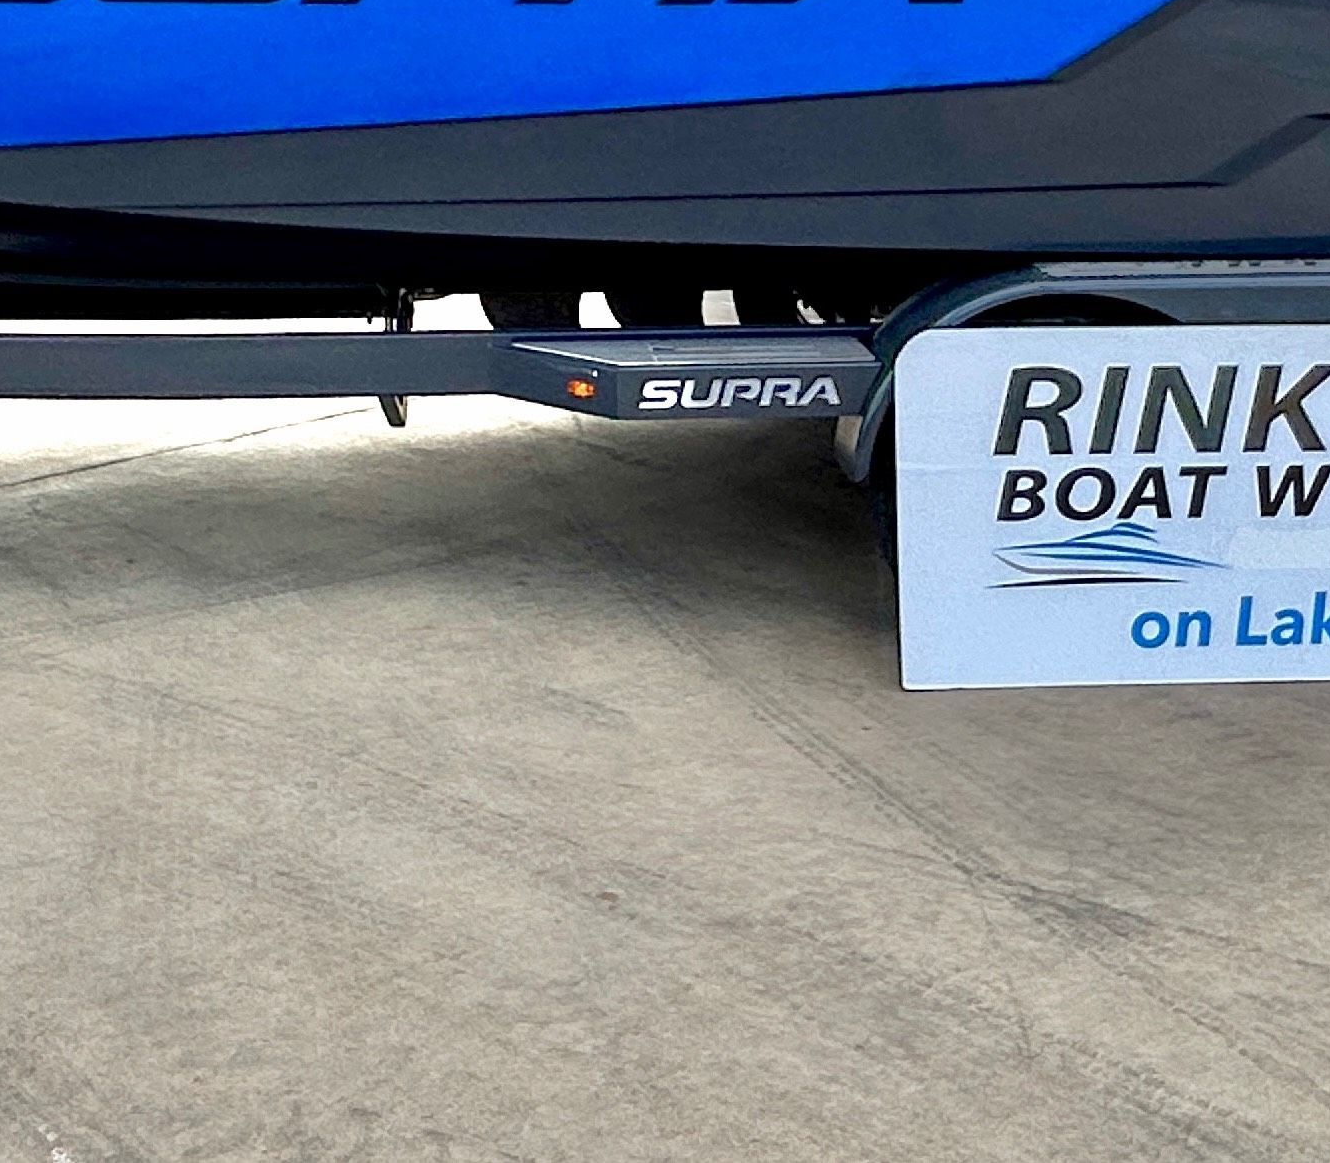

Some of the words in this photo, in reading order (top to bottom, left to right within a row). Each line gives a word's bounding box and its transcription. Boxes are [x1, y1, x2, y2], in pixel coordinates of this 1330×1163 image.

[638, 376, 842, 410] SUPRA
[996, 464, 1228, 522] BOAT
[1130, 609, 1213, 649] on
